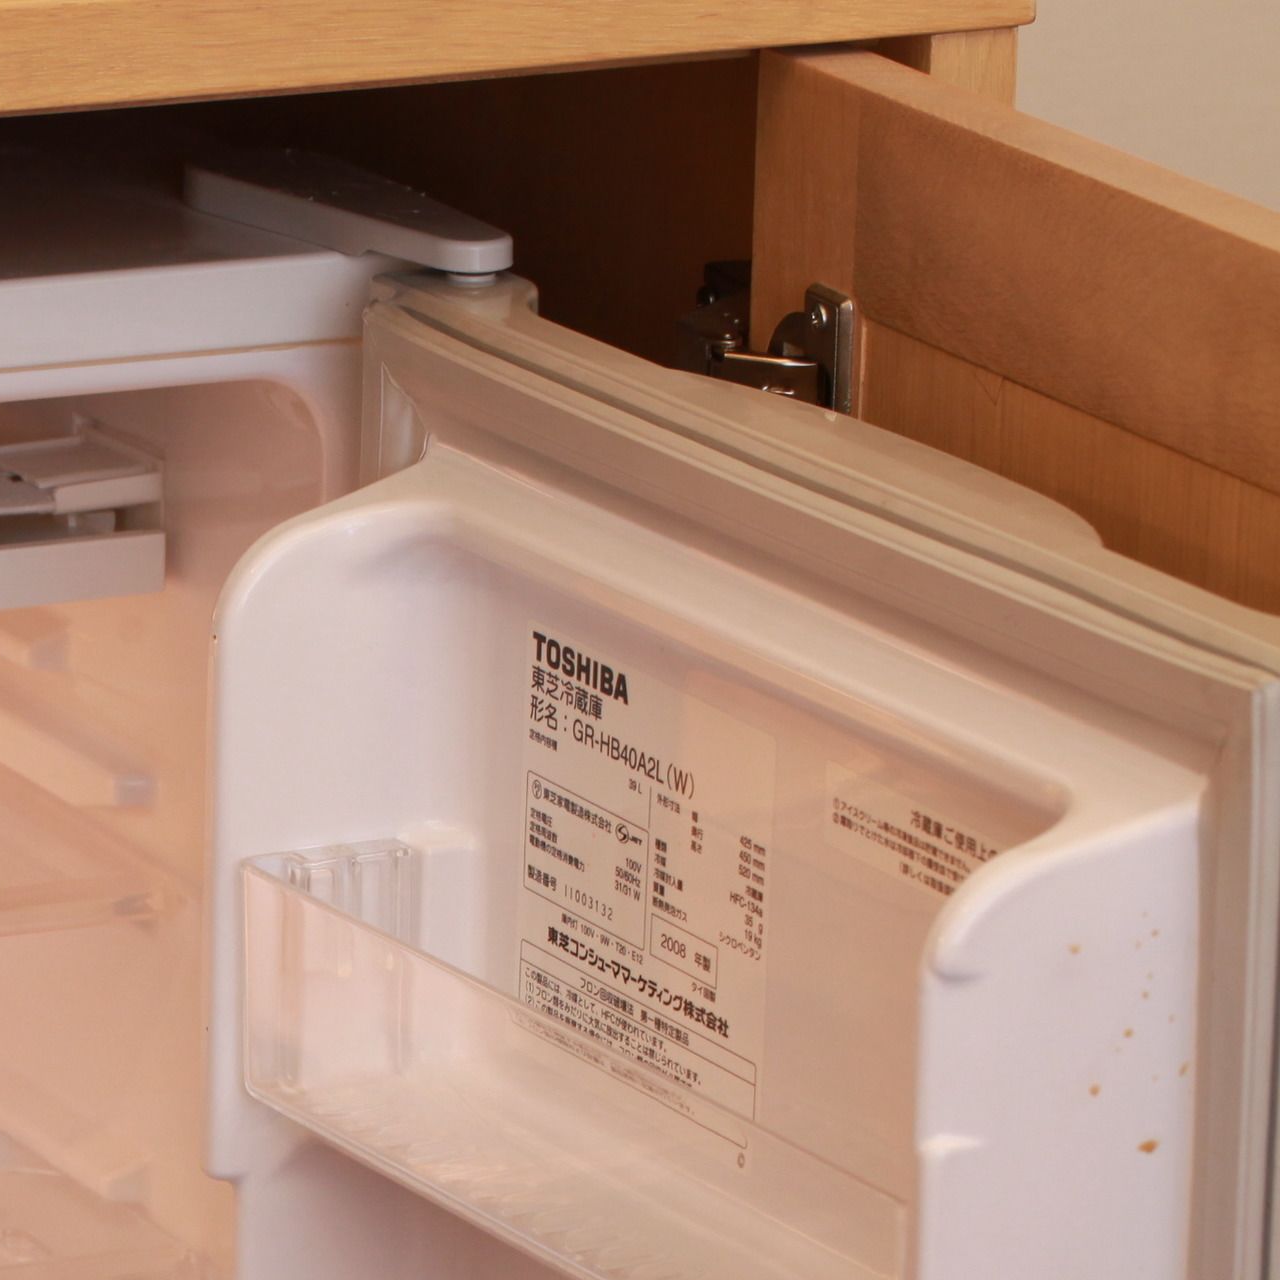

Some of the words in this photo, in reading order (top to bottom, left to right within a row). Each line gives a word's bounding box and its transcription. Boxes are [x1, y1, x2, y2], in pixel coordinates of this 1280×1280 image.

[531, 664, 604, 720] 東芝冷蔵庫
[532, 631, 629, 706] TOSHIBA
[530, 807, 552, 828] 定格電圧
[542, 787, 612, 833] 東芝家電製造株式会社
[527, 864, 557, 892] 製造番号
[564, 884, 614, 921] 11003132
[660, 933, 686, 959] 2008
[694, 952, 711, 973] 年製
[547, 926, 729, 1039] 東芝コンシューママーケティング株式会社
[641, 1010, 689, 1046] 第一種特定製品
